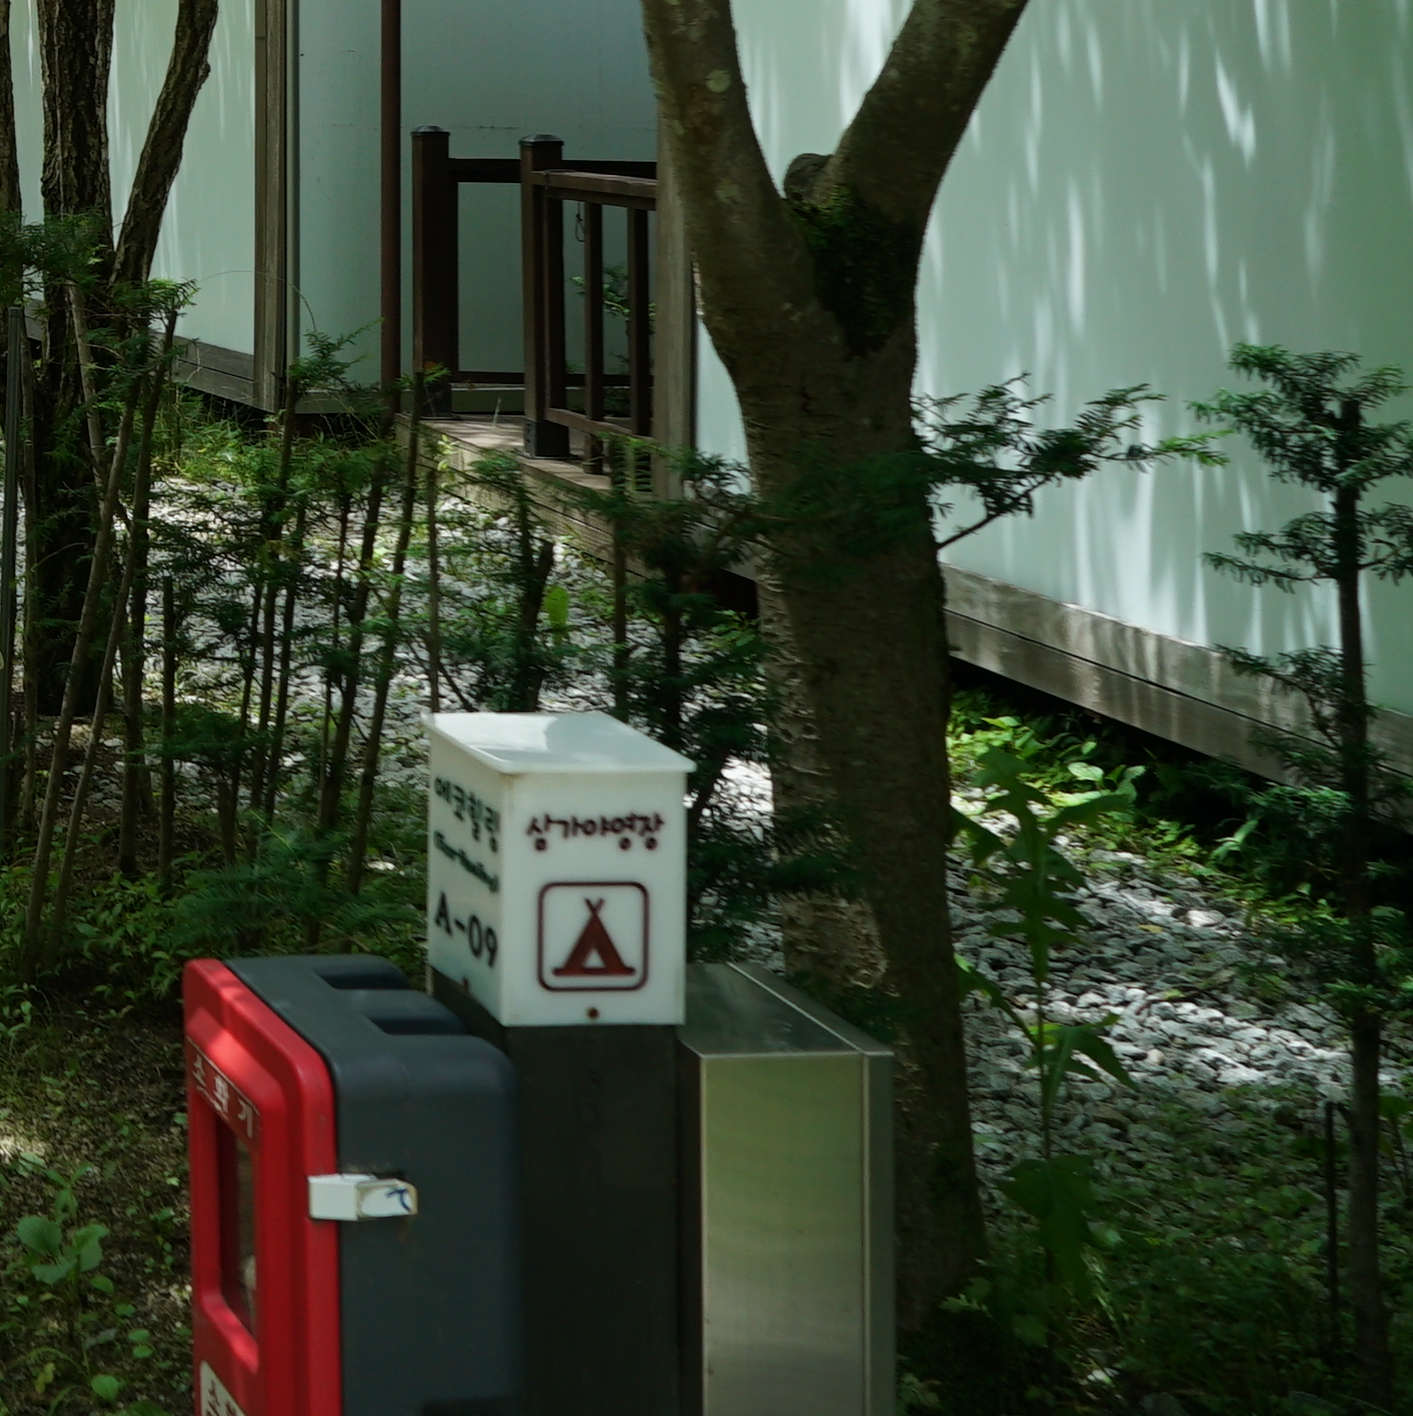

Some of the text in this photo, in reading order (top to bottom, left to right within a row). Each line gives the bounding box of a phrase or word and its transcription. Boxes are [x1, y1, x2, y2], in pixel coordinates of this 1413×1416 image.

[434, 777, 501, 853] 에코힐링
[525, 811, 666, 852] 삼가야영장
[434, 890, 499, 969] A-09
